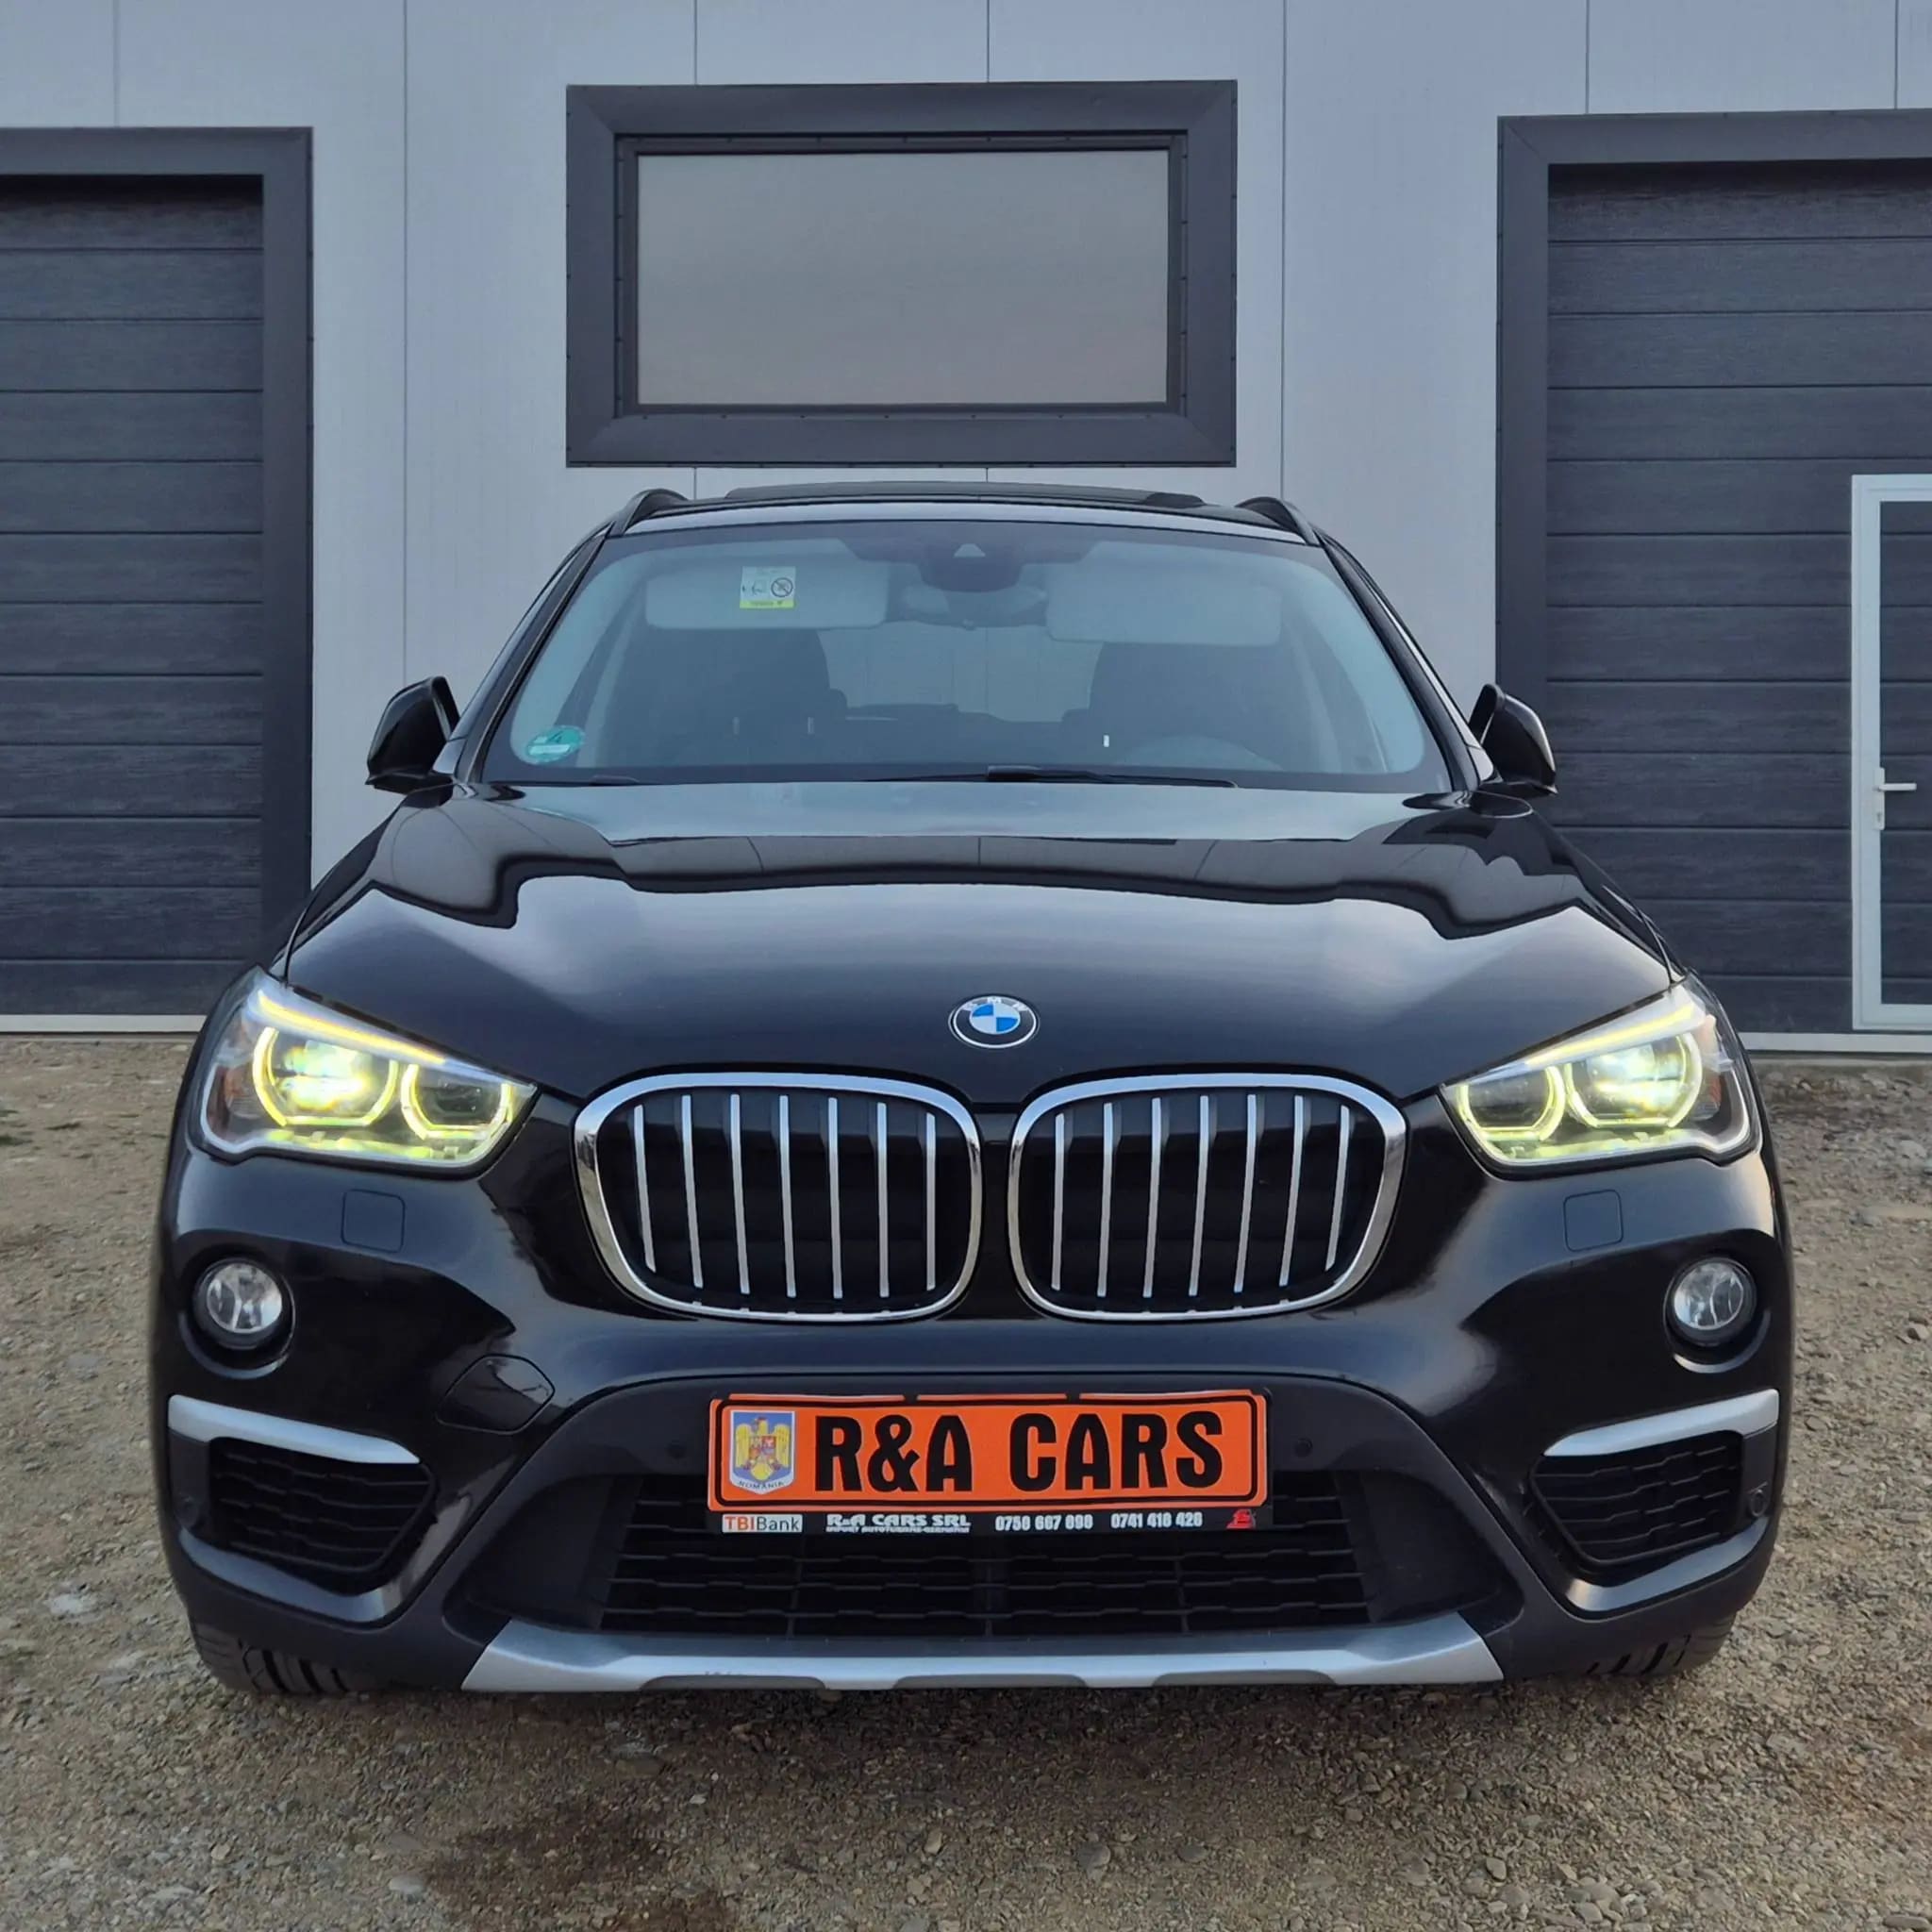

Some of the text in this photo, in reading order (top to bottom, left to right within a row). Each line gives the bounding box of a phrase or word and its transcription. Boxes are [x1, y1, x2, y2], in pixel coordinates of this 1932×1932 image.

[814, 1410, 1223, 1492] R&A CARS
[872, 1514, 927, 1526] CARS
[932, 1514, 971, 1526] SRL
[1111, 1513, 1143, 1528] 0741
